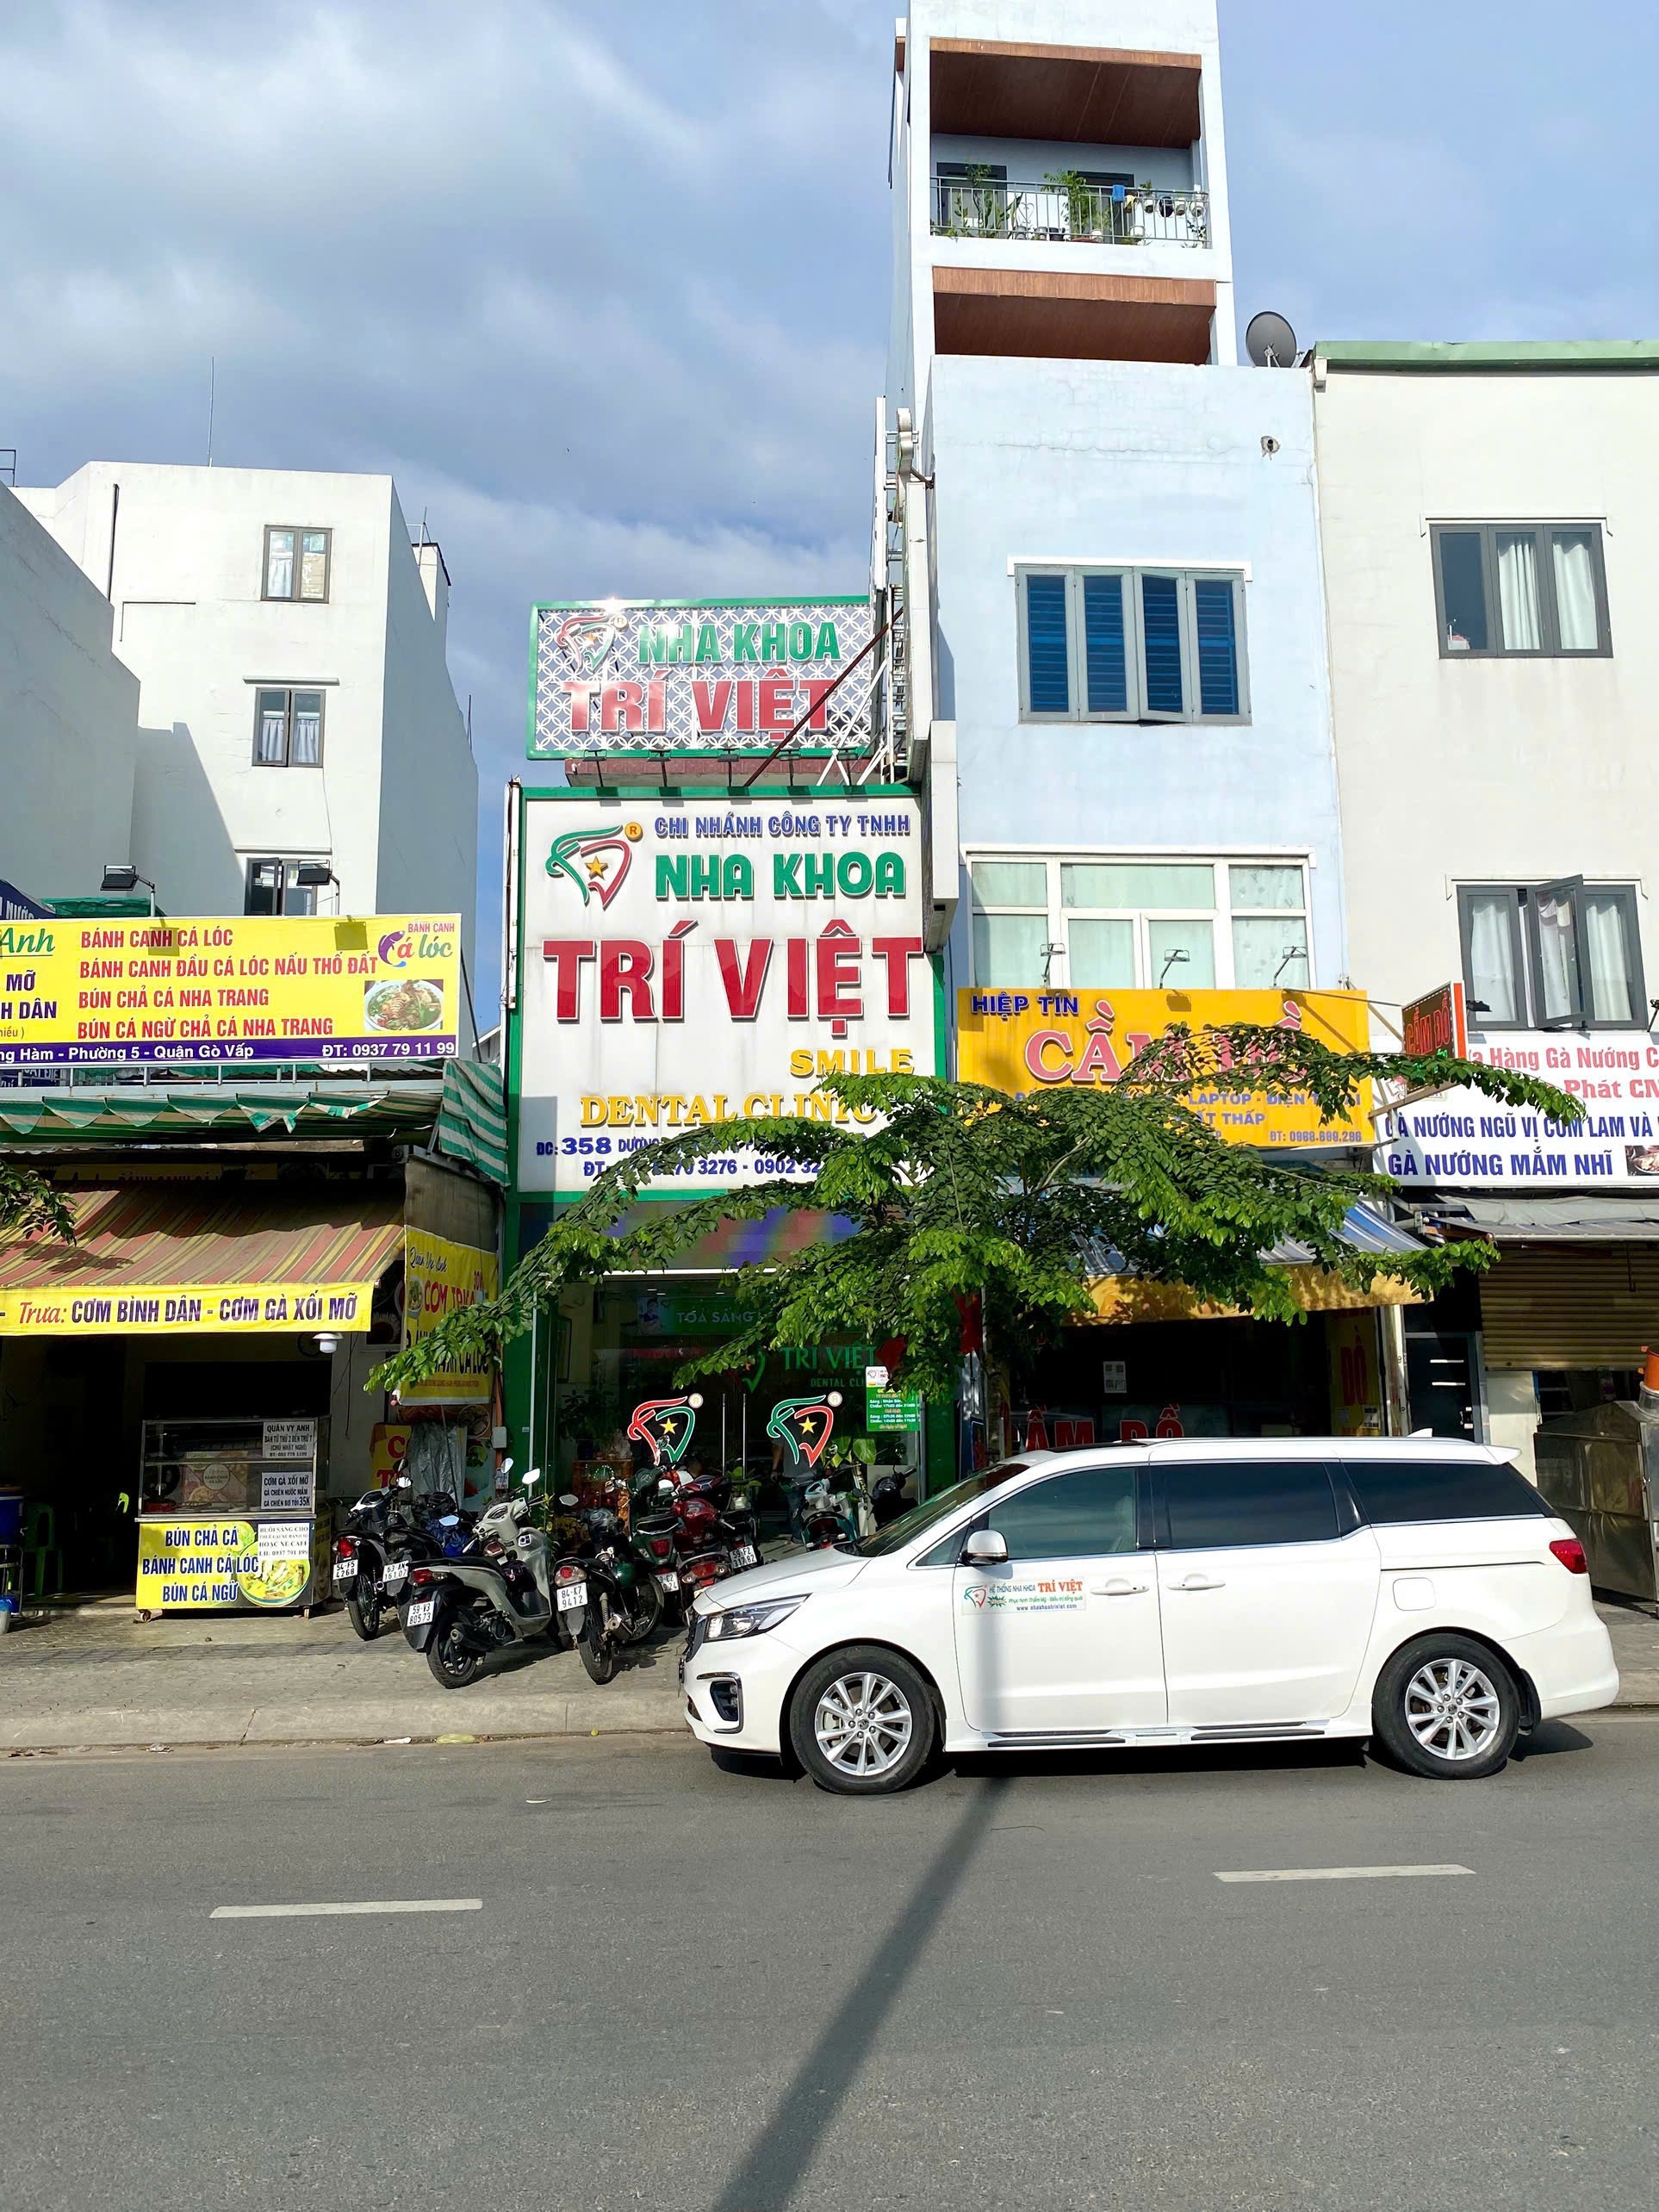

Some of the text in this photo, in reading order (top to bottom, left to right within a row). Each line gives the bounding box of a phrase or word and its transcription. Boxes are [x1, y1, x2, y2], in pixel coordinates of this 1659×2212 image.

[638, 620, 841, 664] NHA KHOA
[562, 667, 840, 741] TRÍ VIỆT
[655, 811, 910, 837] CHI NHÁNH CÔNG TY TNHH
[655, 851, 906, 899] NHA KHOA
[81, 925, 233, 948] BÁNH CANH CÁ LÓC
[407, 922, 455, 933] BÁNH CANH
[419, 934, 453, 958] lóc
[79, 958, 123, 979] BÁNH
[128, 960, 171, 978] CANH
[177, 954, 208, 977] ĐẦU
[214, 955, 234, 976] CÁ
[239, 954, 269, 975] LÓC
[275, 952, 307, 975] NẤU
[348, 951, 377, 974] ĐẤT
[6, 970, 36, 991] MỠ
[543, 918, 924, 1036] TRÍ VIỆT
[19, 997, 57, 1020] DÂN
[78, 985, 269, 1009] BÚN CHẢ CÁ NHA TRANG
[971, 989, 1079, 1020] HIỆP TÍN
[78, 1014, 333, 1040] BÚN CÁ NGỪ CHẢ CÁ NHA TRANG
[20, 1042, 254, 1062] Hàm Phường 5 Quận Gò Vấp
[322, 1041, 455, 1057] ĐT: 0937 79 11 99
[1489, 1047, 1539, 1071] Hàng
[1546, 1047, 1570, 1068] Gà
[1577, 1047, 1640, 1071] Nướng
[790, 1047, 915, 1077] SMILE
[1189, 1092, 1252, 1105] LAPTOP
[1564, 1079, 1622, 1098] Phát
[580, 1094, 737, 1127] DENTAL
[1221, 1109, 1265, 1125] THẤP
[1414, 1112, 1475, 1137] NƯỚNG
[1480, 1112, 1516, 1137] NGŨ
[1522, 1116, 1538, 1143] VỊ
[1588, 1116, 1625, 1137] LAM
[1629, 1111, 1653, 1137] VÀ
[537, 1136, 612, 1155] ĐC: 358
[698, 1159, 737, 1175] 3276
[754, 1159, 796, 1174] 0902
[1388, 1146, 1612, 1175] GÀ NƯỚNG MẮM NHĨ
[20, 1289, 358, 1324] Trưa: CƠM BÌNH DÂN CƠM GÀ XỐI MỠ
[811, 1378, 845, 1388] DENTAL
[267, 1423, 285, 1432] QUÁN
[299, 1496, 310, 1506] 35K
[165, 1524, 239, 1547] BÚN CHẢ CÁ
[142, 1554, 259, 1575] BÁNH CANH CÁ LÓC
[162, 1581, 239, 1602] BÚN CÁ NGỪ
[1037, 1580, 1056, 1593] TRÍ
[1058, 1579, 1083, 1594] VIỆT
